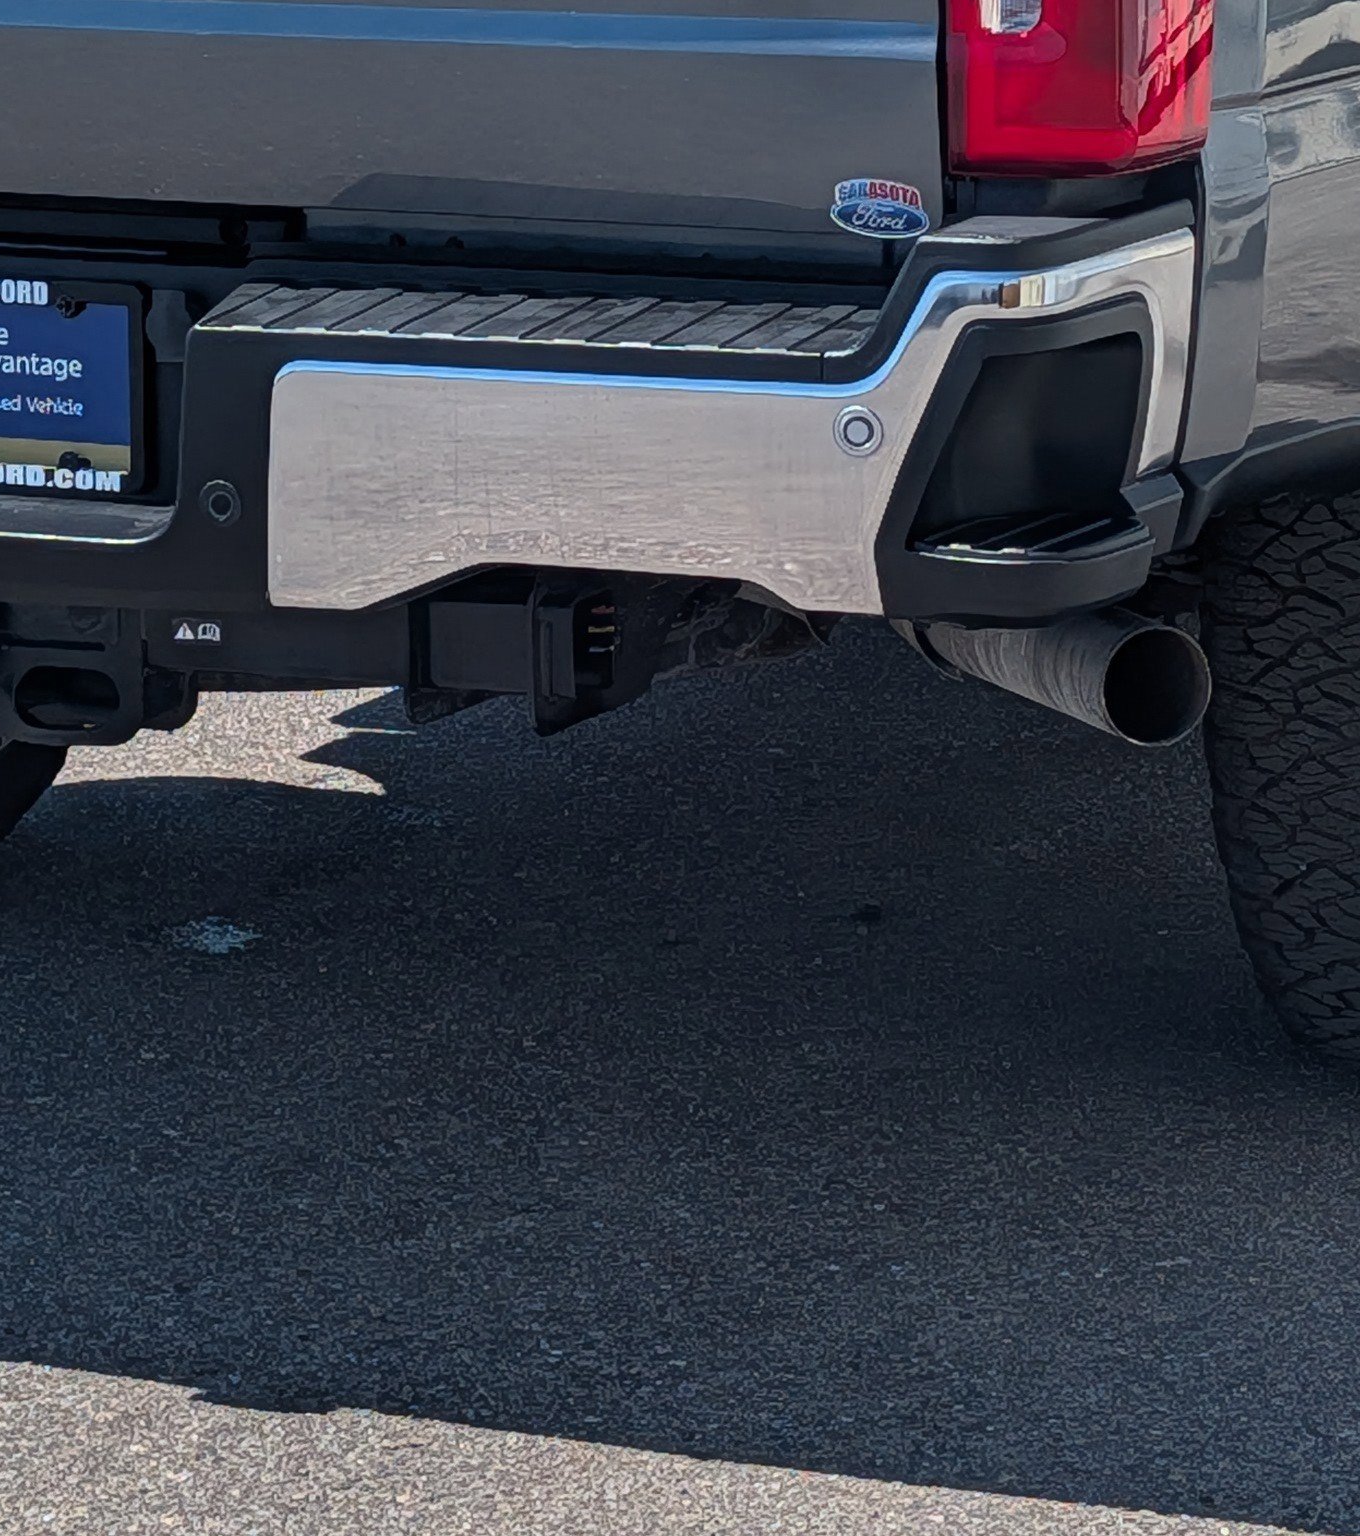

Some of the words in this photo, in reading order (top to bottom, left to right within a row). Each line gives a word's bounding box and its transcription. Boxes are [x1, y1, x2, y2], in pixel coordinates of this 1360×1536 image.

[839, 180, 920, 208] SARASOTA
[851, 203, 908, 230] Ford
[26, 397, 84, 417] Vehicle
